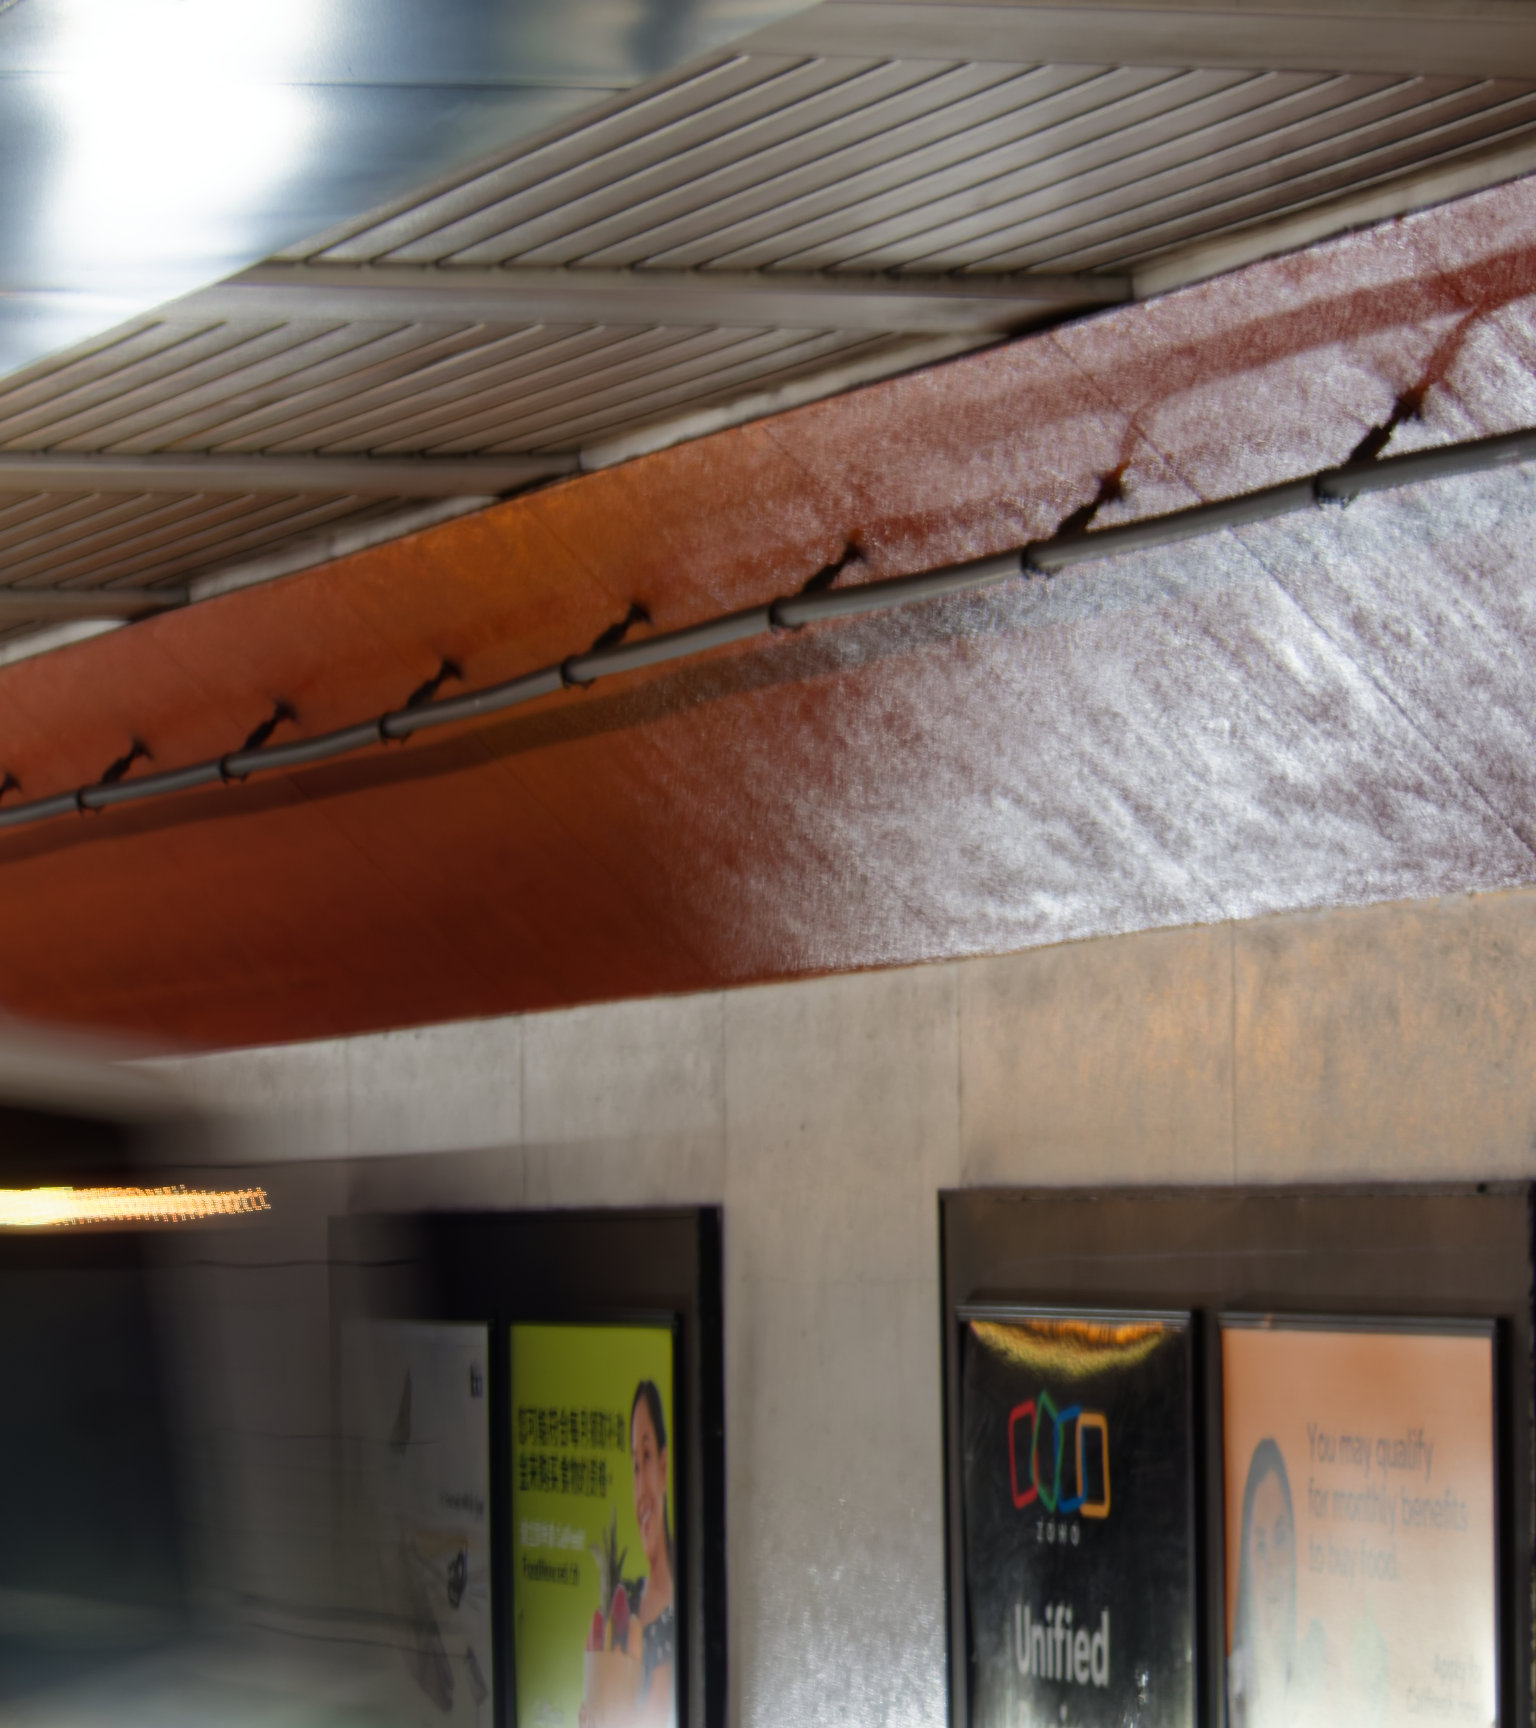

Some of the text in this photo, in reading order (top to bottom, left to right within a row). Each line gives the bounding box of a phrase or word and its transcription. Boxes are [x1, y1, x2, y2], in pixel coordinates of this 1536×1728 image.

[1305, 1422, 1337, 1464] You
[1036, 1520, 1081, 1547] ZOHO
[1013, 1603, 1111, 1688] Unified
